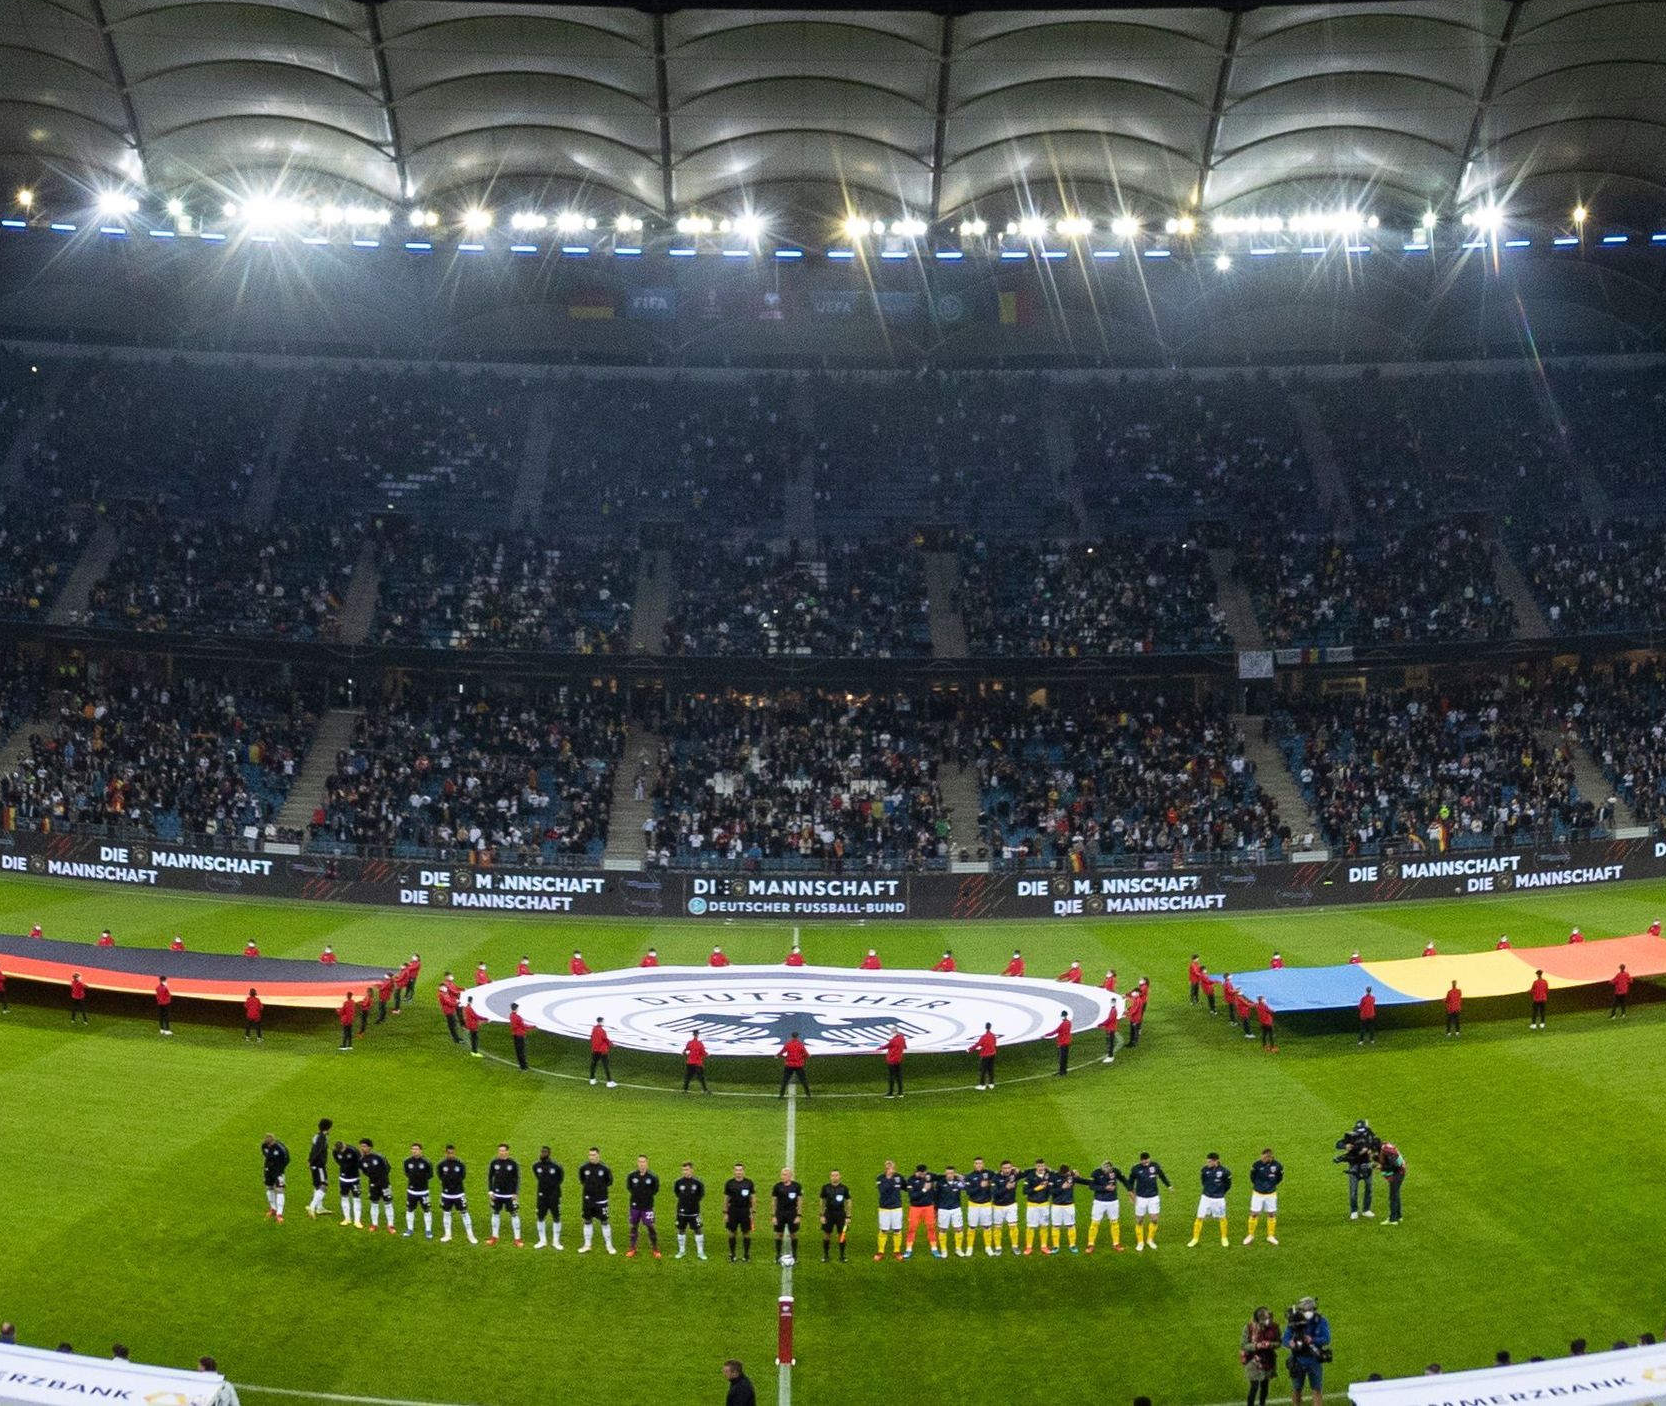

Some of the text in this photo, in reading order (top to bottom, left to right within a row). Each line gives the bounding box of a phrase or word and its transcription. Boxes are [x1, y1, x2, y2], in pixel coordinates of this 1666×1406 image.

[634, 297, 668, 309] FIFA
[1, 854, 159, 884] DIE MANNSCHAFT
[100, 846, 273, 876] DIE MANNSCHAFT
[1348, 855, 1521, 883] DIE MANNSCHAFT
[420, 870, 451, 887] DIE
[475, 873, 605, 894] MNNSCHAFT
[748, 879, 899, 896] MANNSCHAFT
[1017, 875, 1199, 897] DIE MNNSCHAFT
[1467, 864, 1623, 892] DIE MANNSCHAFT
[400, 889, 574, 911] DIE MANNSCHAFT
[709, 901, 906, 914] DEUTSCHER FUSSBALL-BUND
[1054, 894, 1227, 915] DIE MANNSCHAFT
[634, 991, 952, 1010] DEUTSCHER
